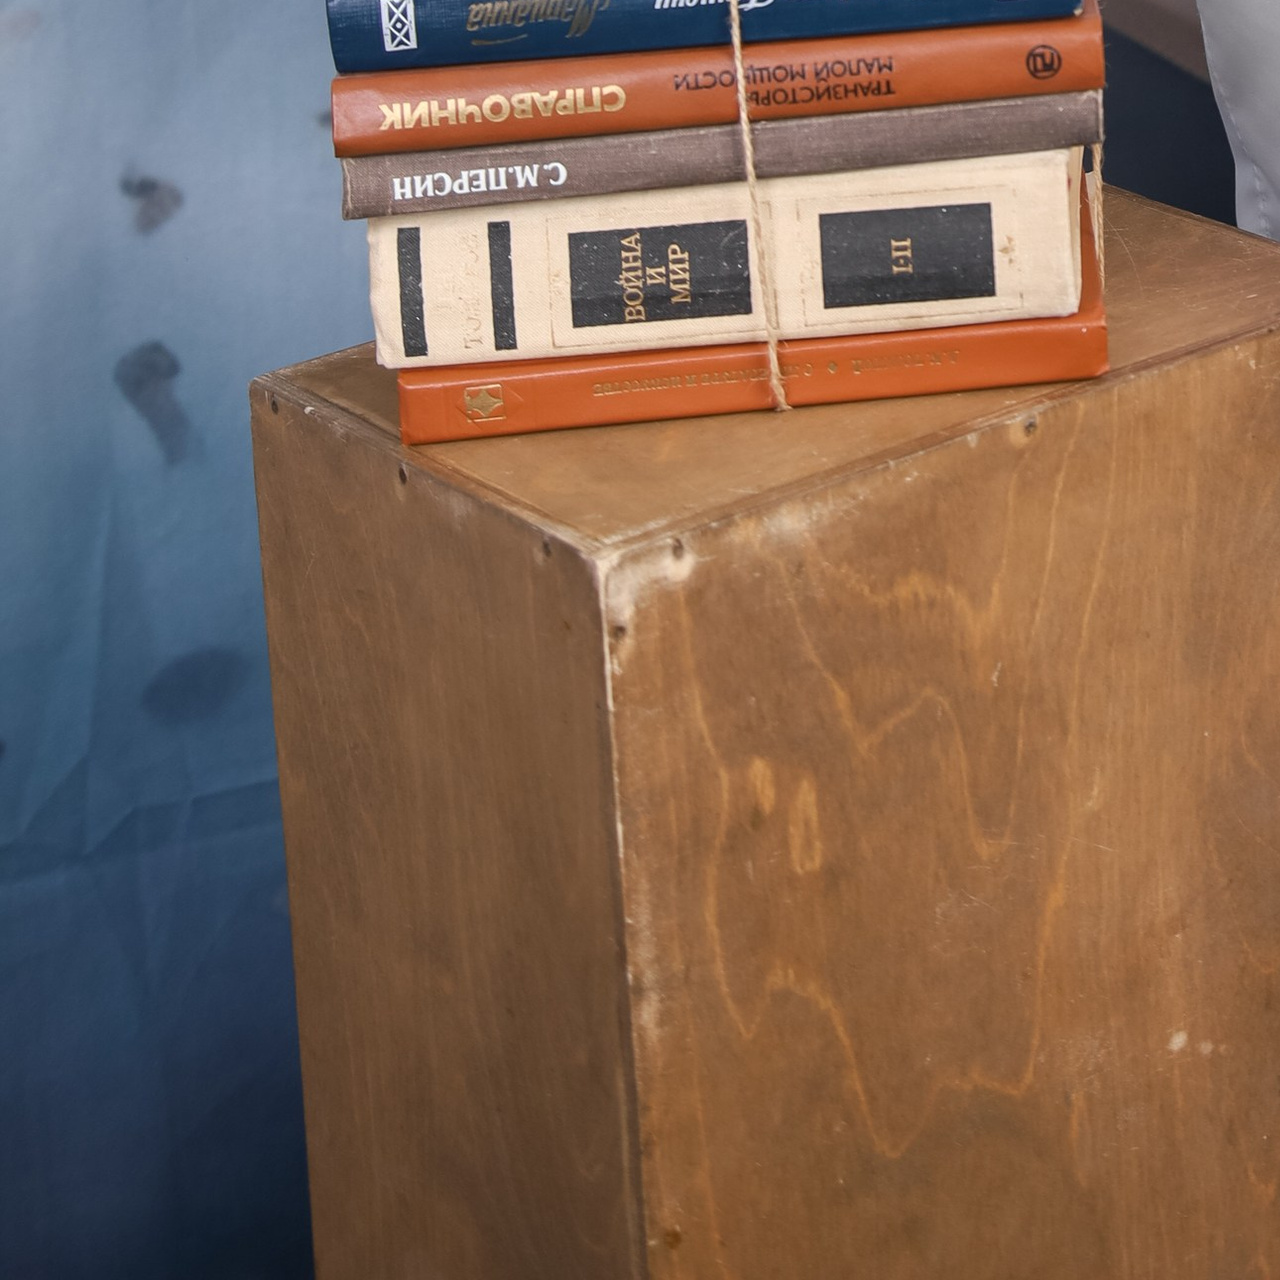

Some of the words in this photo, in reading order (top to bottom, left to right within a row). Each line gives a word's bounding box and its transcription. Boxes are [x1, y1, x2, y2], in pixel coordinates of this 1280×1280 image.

[813, 56, 894, 82] МАЛОЙ
[378, 84, 627, 131] СПРАВОЧНИК
[618, 231, 647, 323] ВОЙНА
[645, 265, 668, 287] И
[667, 242, 692, 305] МИР
